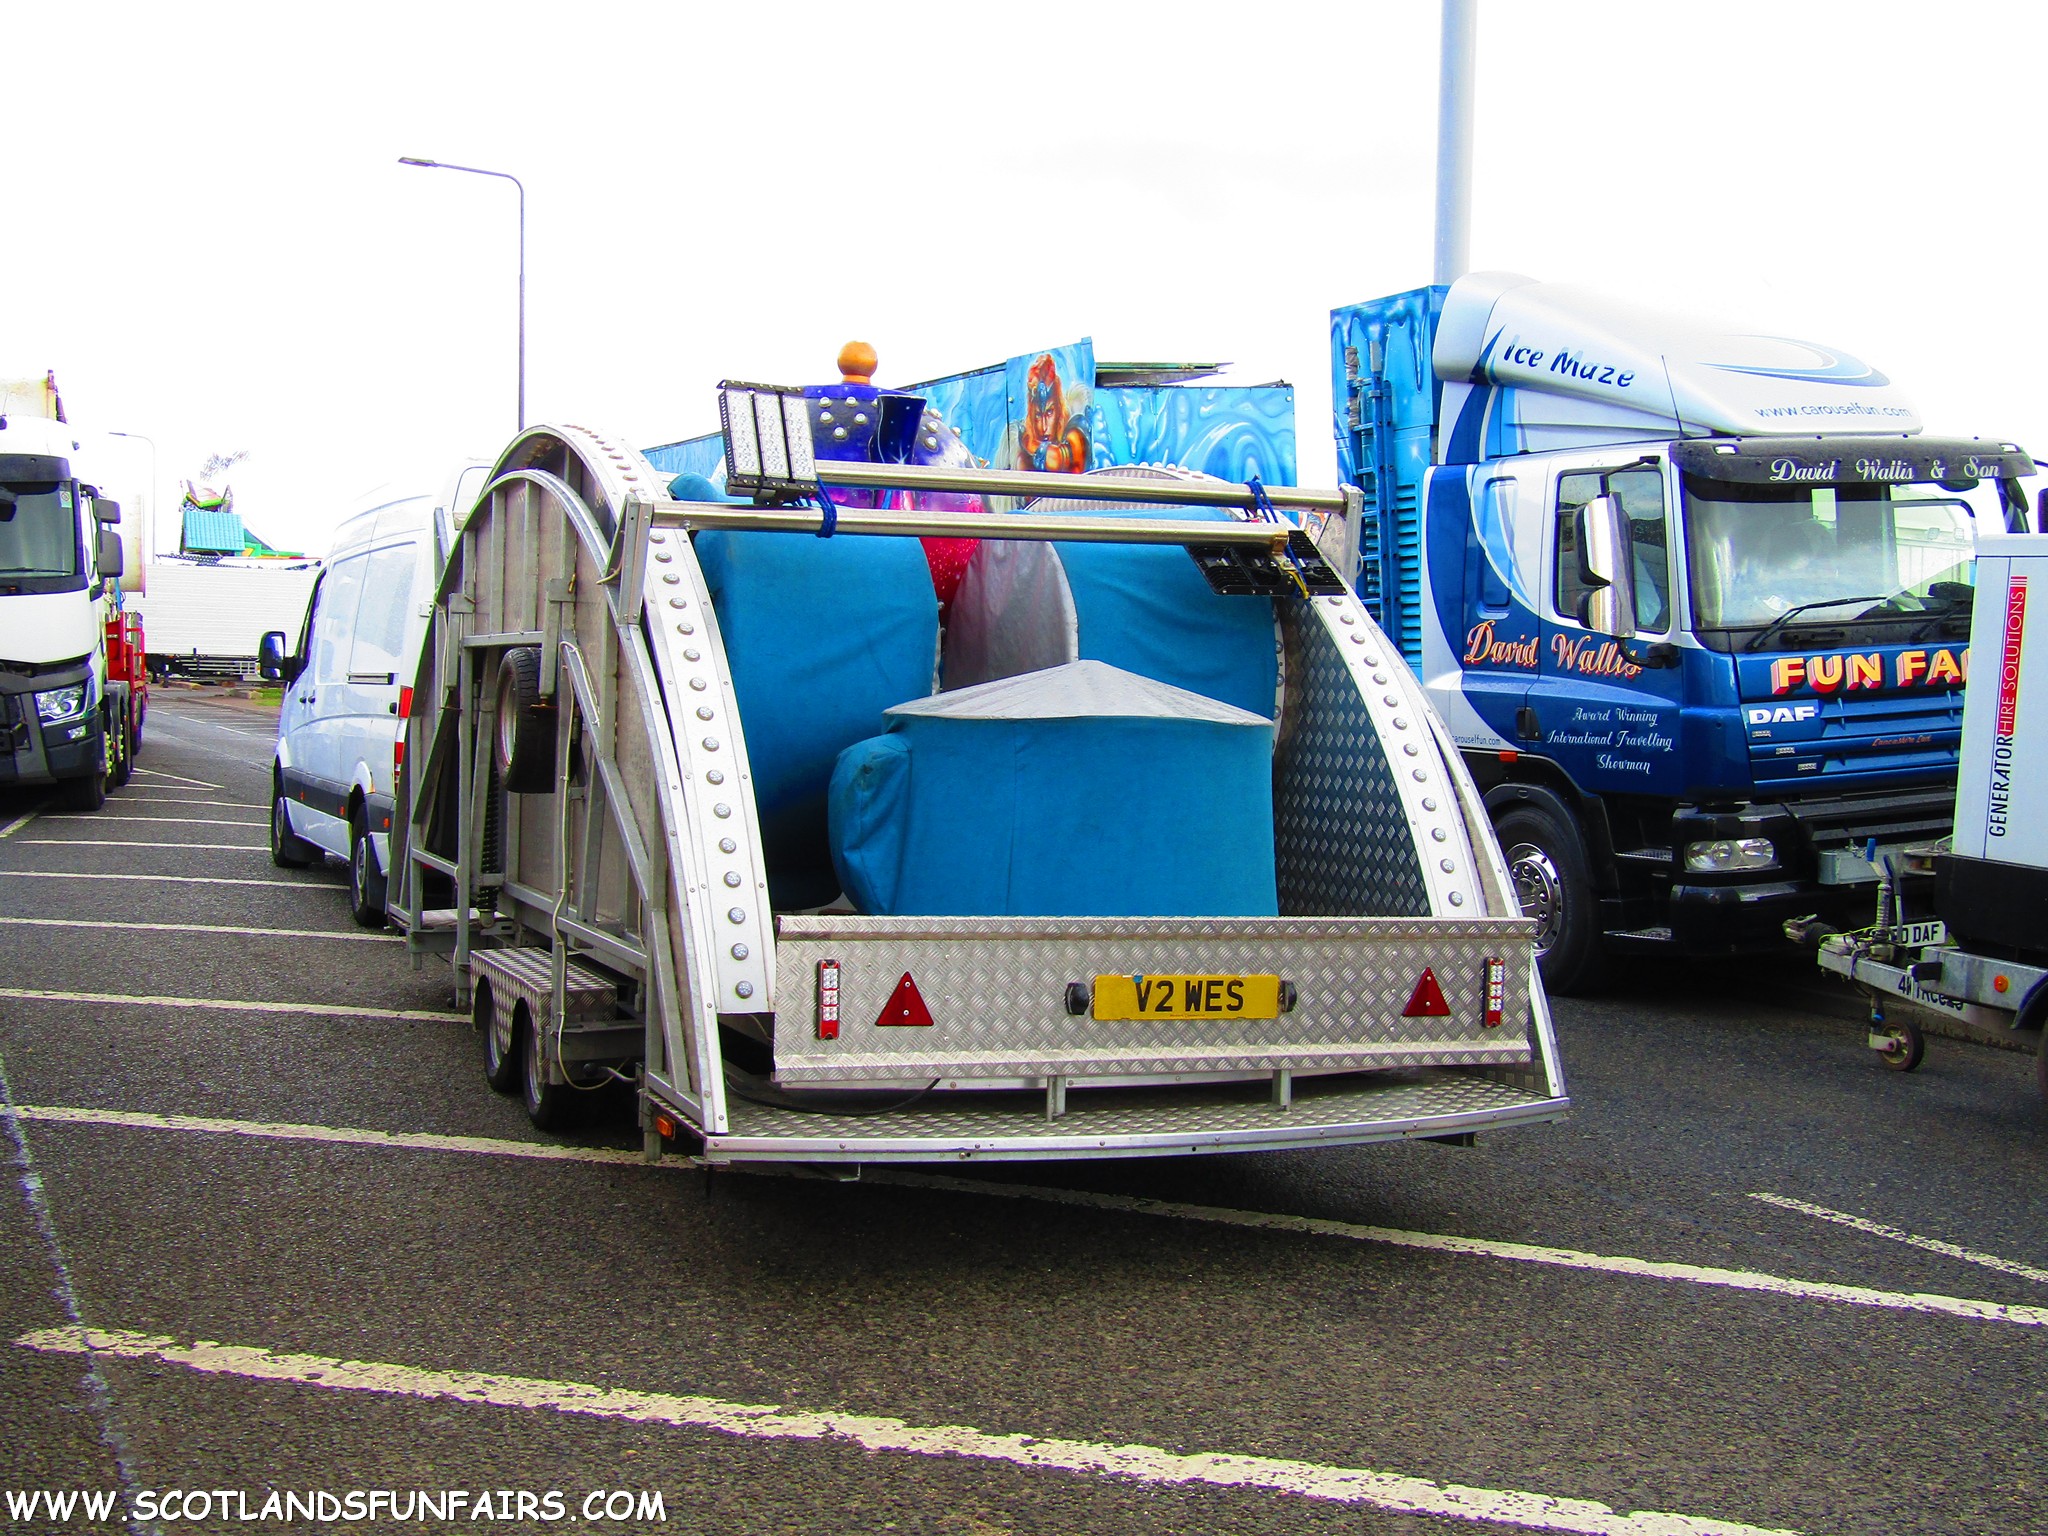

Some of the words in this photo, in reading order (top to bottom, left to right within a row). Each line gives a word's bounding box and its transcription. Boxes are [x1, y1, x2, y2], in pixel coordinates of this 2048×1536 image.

[1503, 334, 1544, 368] Ice
[1550, 346, 1636, 388] Maze
[1754, 402, 1912, 418] www.carouselfun.com
[1769, 458, 1836, 481] David
[1855, 458, 1914, 480] Wallis
[1930, 459, 1946, 479] &
[1963, 456, 2000, 478] Son
[1464, 619, 1540, 668] David
[1551, 632, 1643, 679] Wallis
[2003, 590, 2025, 691] SOLUTIONS
[1770, 652, 1883, 695] FUN
[1896, 649, 1971, 688] FA
[1572, 706, 1612, 722] Award
[1616, 706, 1659, 728] Winning
[1748, 706, 1816, 724] DAF
[1999, 696, 2015, 733] HIRE
[1452, 733, 1500, 746] arouselfun.com
[1547, 729, 1614, 745] International
[1615, 730, 1674, 752] Travelling
[1596, 753, 1651, 774] Showman
[1989, 734, 2013, 838] GENERATOR
[1912, 923, 1940, 944] DAF
[1135, 980, 1175, 1013] V2
[1184, 980, 1245, 1013] WES
